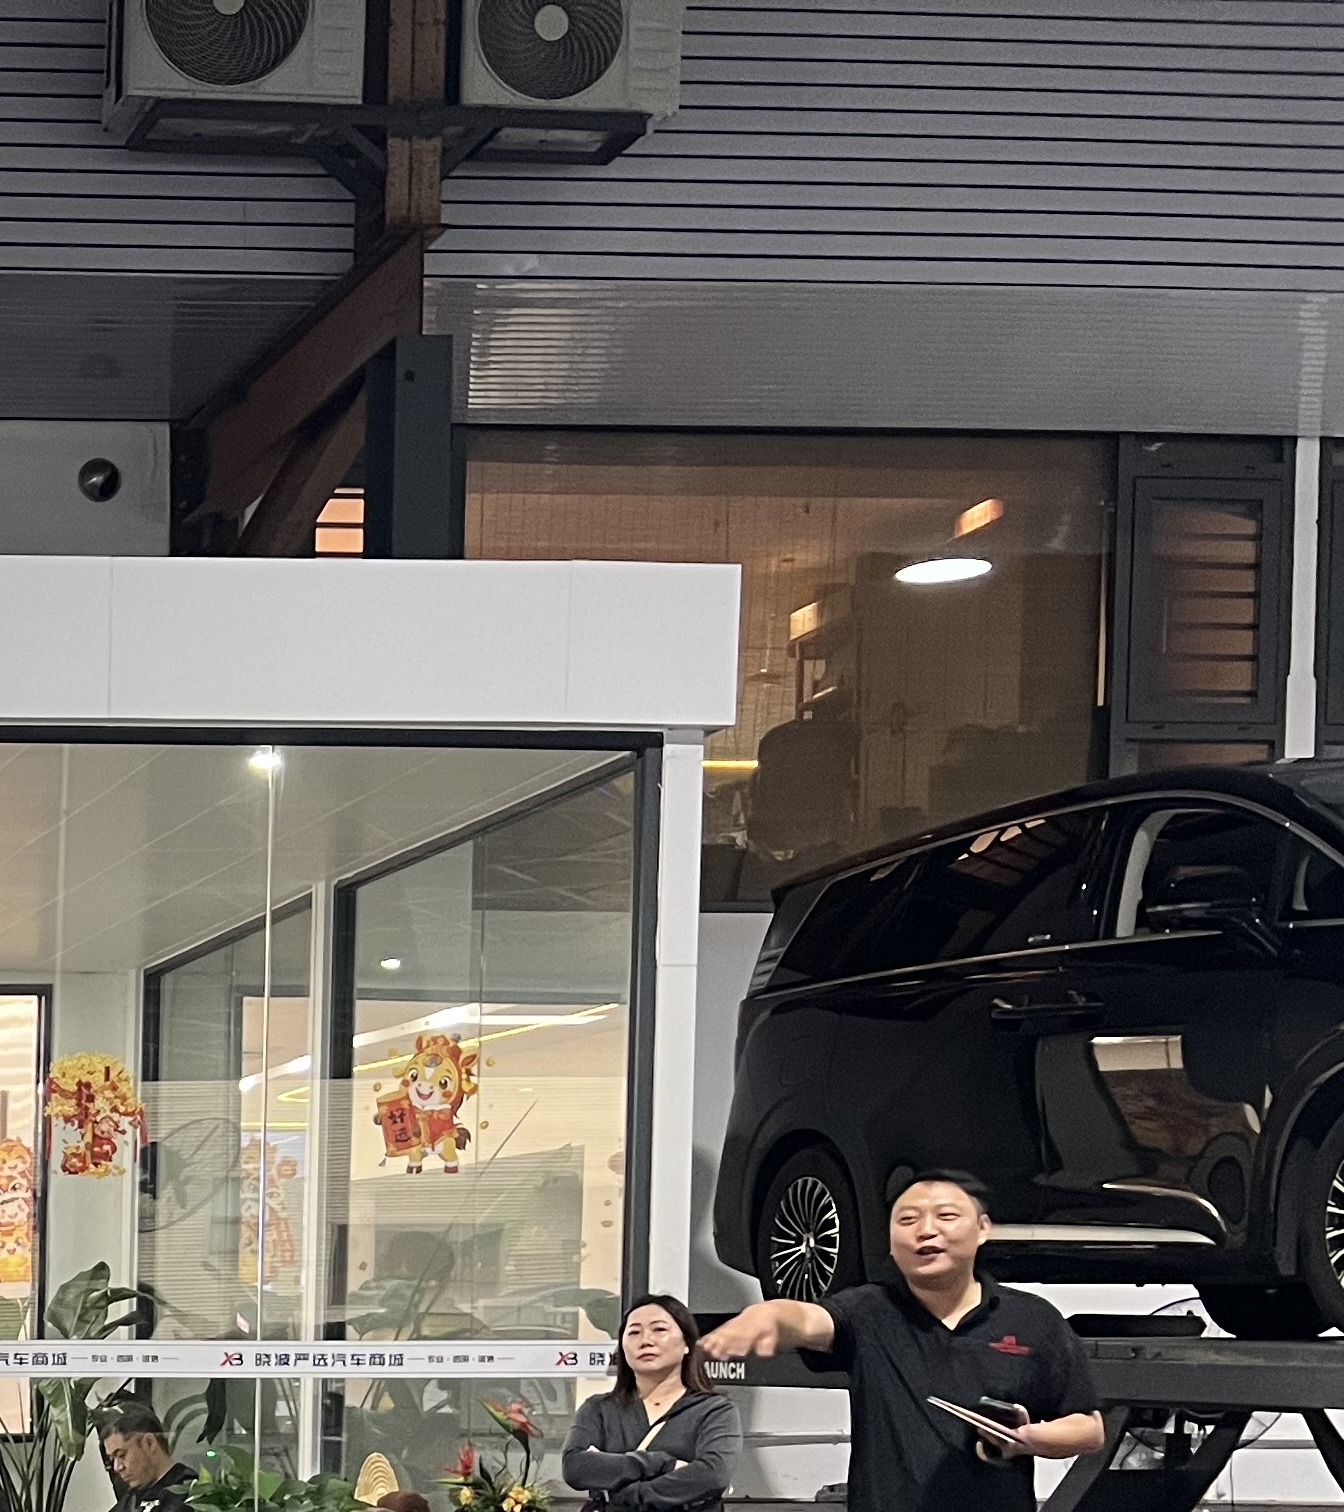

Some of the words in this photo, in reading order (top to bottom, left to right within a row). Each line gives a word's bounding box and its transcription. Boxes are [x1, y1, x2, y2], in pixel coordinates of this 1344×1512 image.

[388, 1108, 411, 1142] 好运
[254, 1352, 404, 1367] 晓波严选汽车商城
